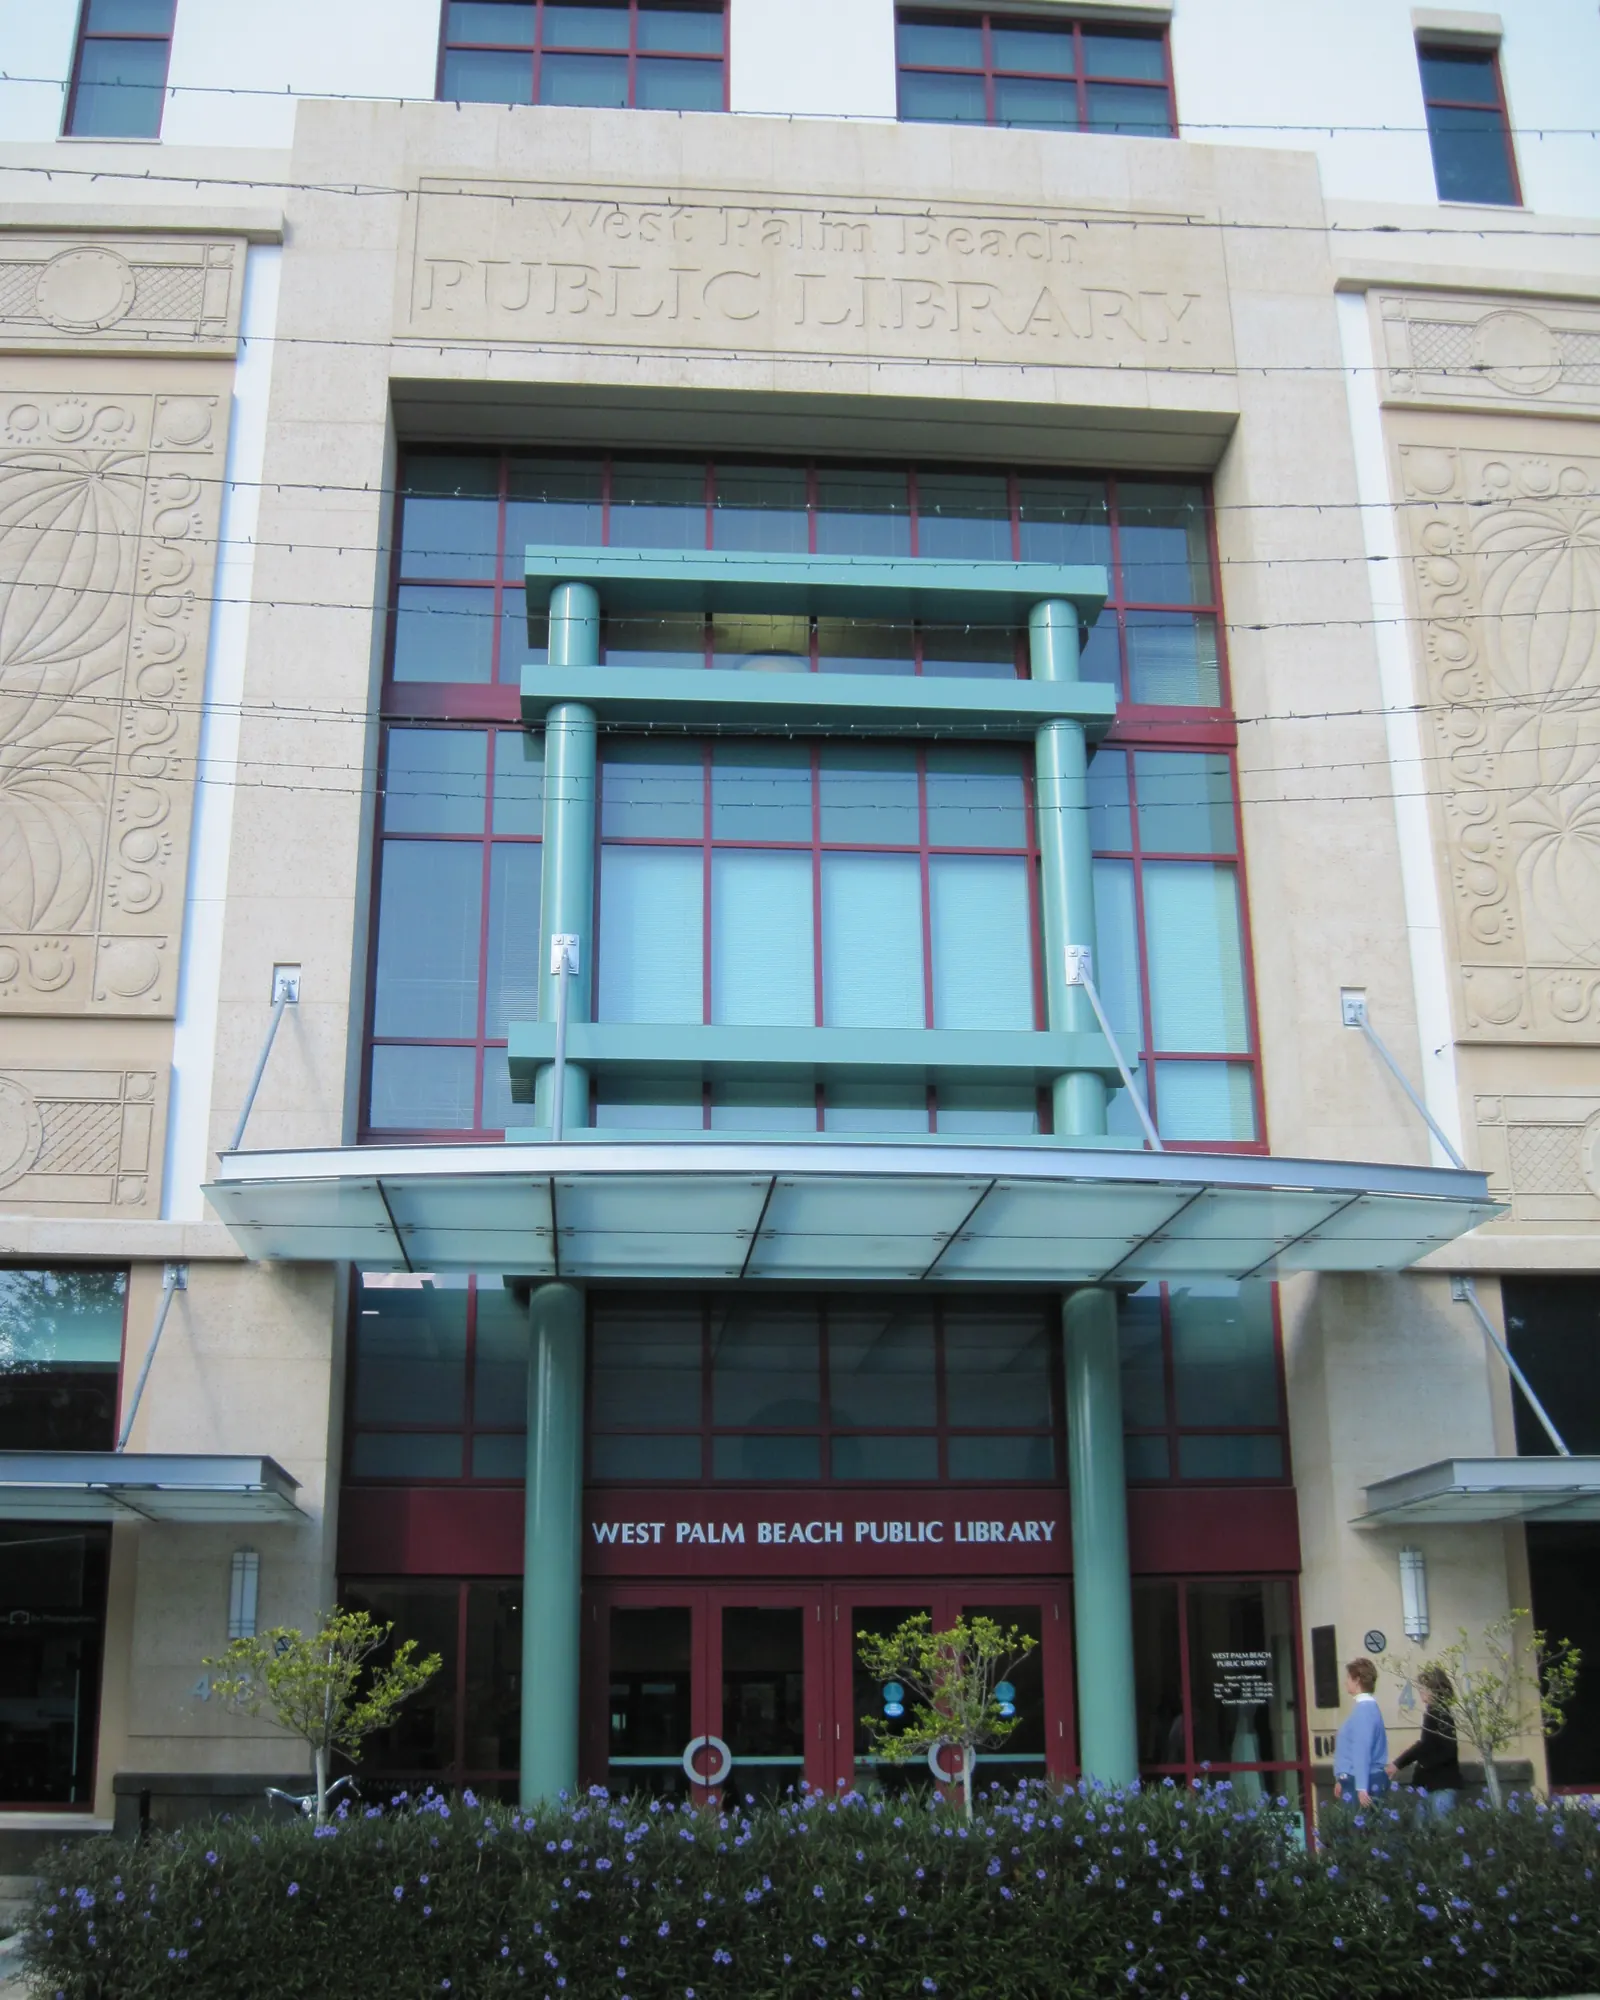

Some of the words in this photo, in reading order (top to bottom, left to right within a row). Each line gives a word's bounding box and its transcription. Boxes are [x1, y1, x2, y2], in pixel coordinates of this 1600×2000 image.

[542, 204, 694, 244] West
[717, 207, 878, 254] Palm
[896, 214, 1085, 265] Beach
[420, 257, 763, 321] PUBLIC
[793, 272, 1203, 345] LIBRARY
[592, 1522, 665, 1544] WEST
[675, 1522, 746, 1544] PALM
[757, 1522, 844, 1544] BEACH
[854, 1521, 944, 1543] PUBLIC
[954, 1520, 1056, 1542] LIBRARY
[1240, 1659, 1267, 1667] LIBRARY
[1249, 1651, 1272, 1659] BEACH
